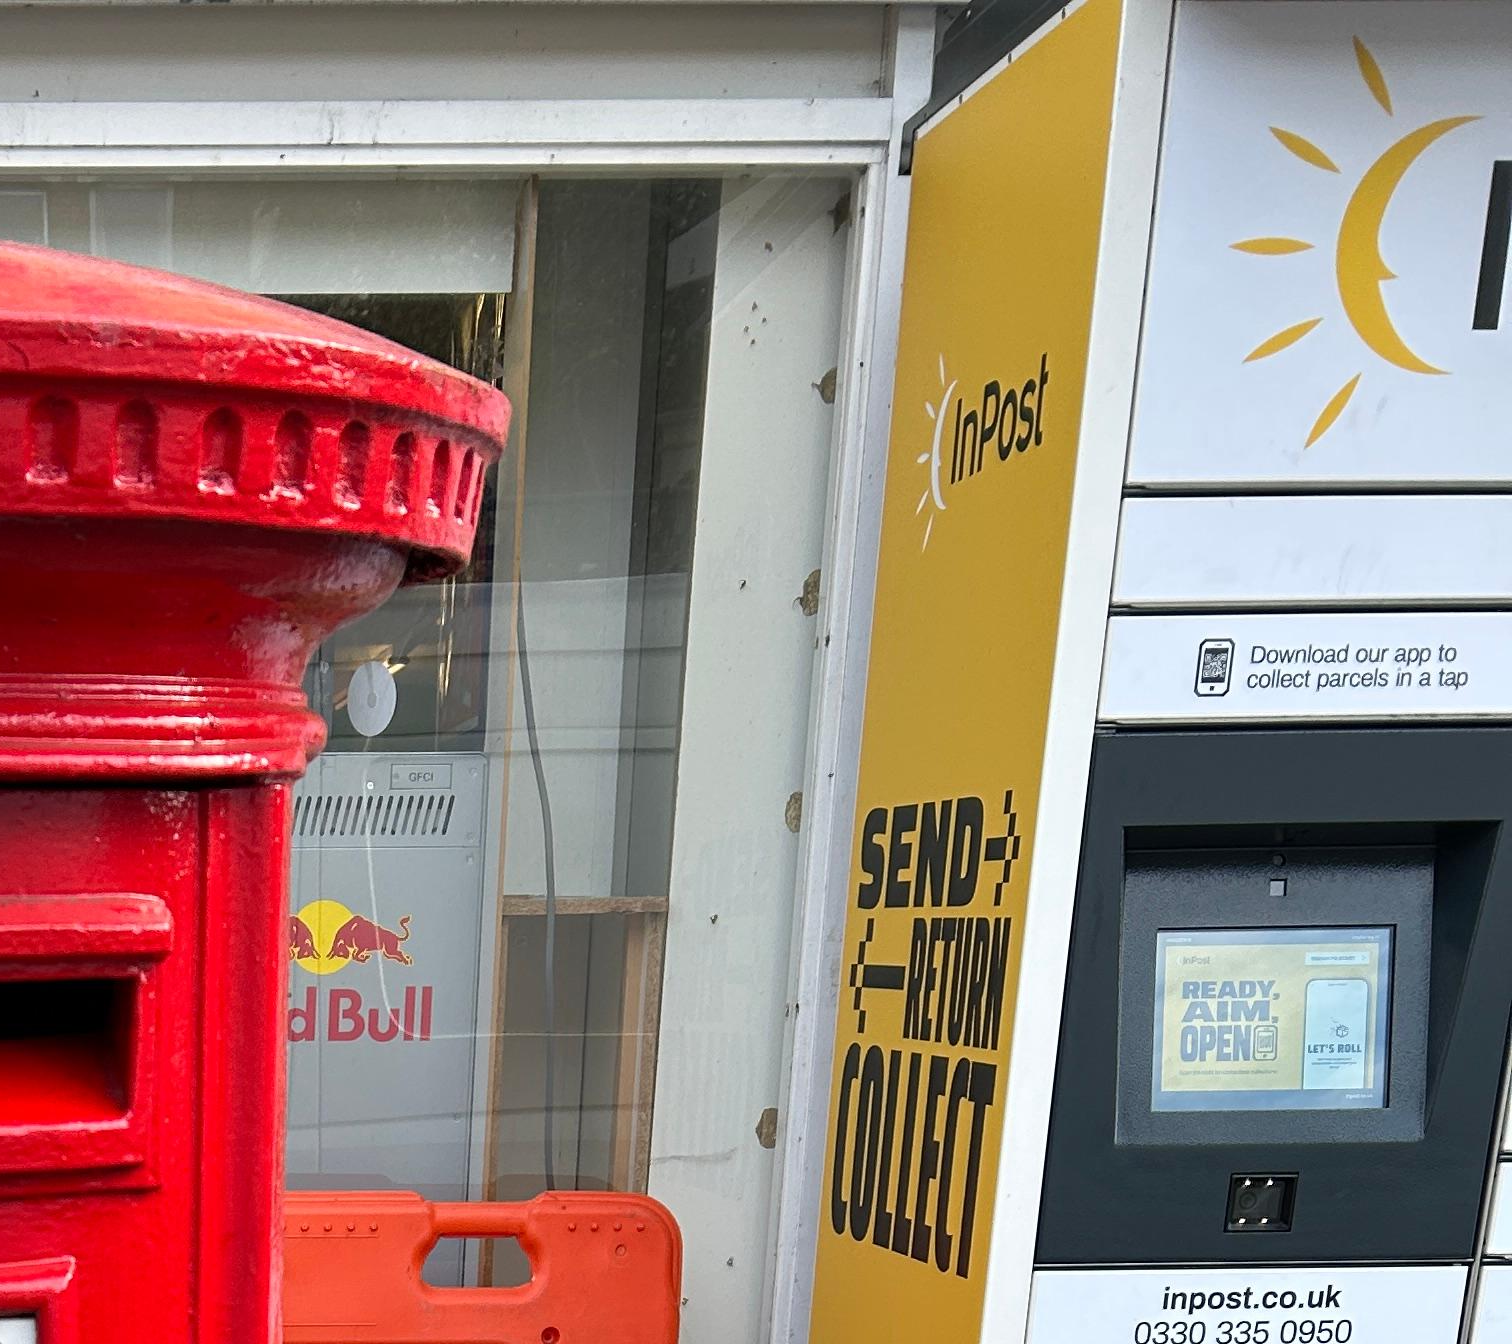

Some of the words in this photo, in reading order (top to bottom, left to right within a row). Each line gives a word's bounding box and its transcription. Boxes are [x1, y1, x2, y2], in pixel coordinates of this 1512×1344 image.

[949, 352, 1050, 486] InPost
[1250, 644, 1350, 664] Download
[1356, 646, 1389, 663] our
[1394, 646, 1431, 666] app
[1438, 644, 1457, 662] to
[1247, 669, 1311, 689] collect
[1316, 668, 1389, 692] parcels
[1396, 668, 1412, 686] in
[1418, 672, 1431, 686] a
[1438, 668, 1468, 690] tap
[408, 771, 434, 783] GFCI
[857, 794, 983, 910] SEND
[902, 915, 1010, 1052] RETURN
[1181, 980, 1280, 1000] READY,
[327, 985, 433, 1042] Bull
[1181, 1000, 1279, 1023] AIM,
[1180, 1025, 1252, 1062] OPEN
[1338, 1043, 1363, 1054] ROLL
[830, 1042, 997, 1280] COLLECT
[1162, 1285, 1342, 1315] inpost.co.uk
[1135, 1322, 1206, 1344] 0330
[1216, 1321, 1270, 1344] 335
[1280, 1320, 1352, 1344] 0950
